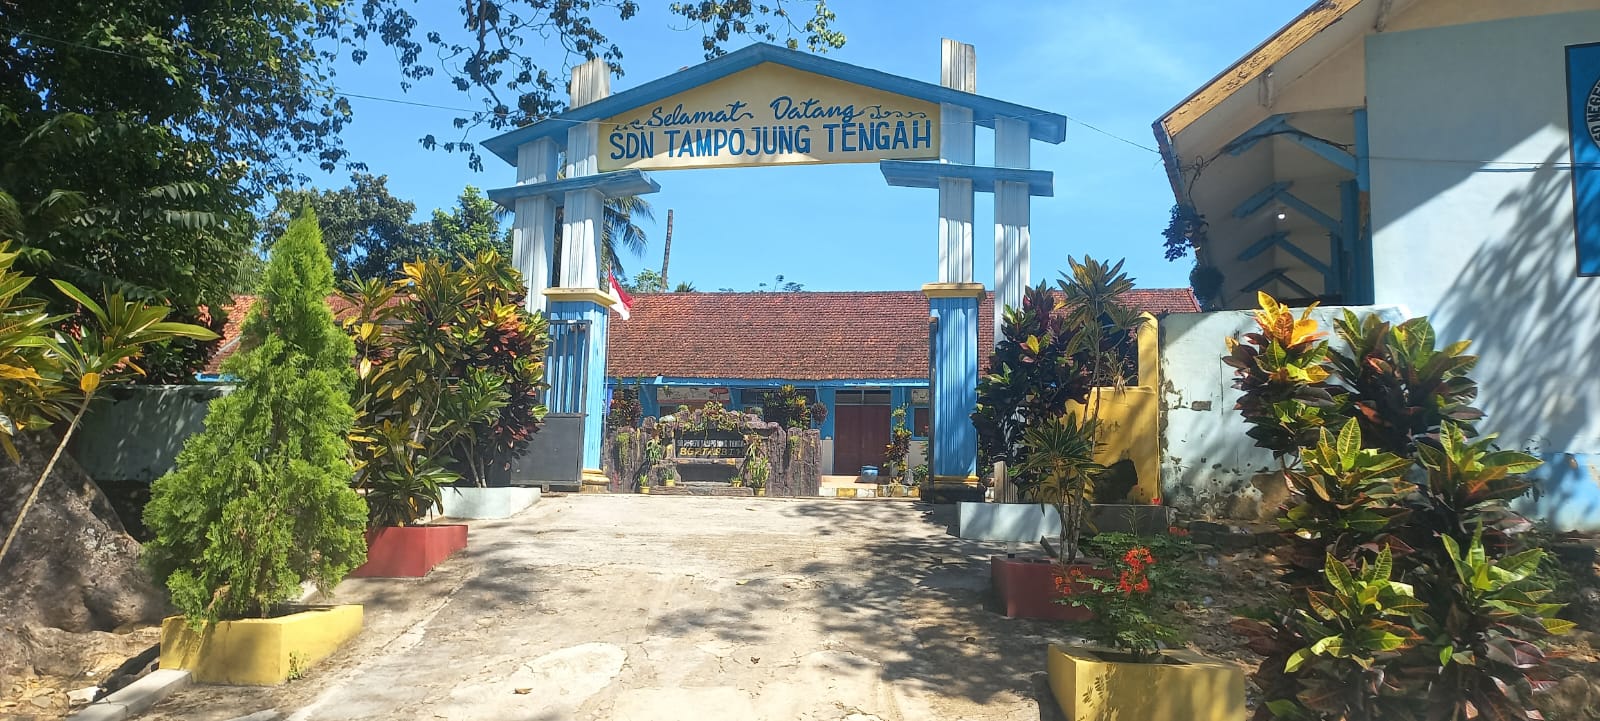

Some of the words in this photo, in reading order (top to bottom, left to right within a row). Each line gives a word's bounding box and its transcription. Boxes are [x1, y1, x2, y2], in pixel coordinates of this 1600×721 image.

[645, 101, 754, 127] Selamat
[770, 96, 862, 121] Datang
[609, 130, 654, 160] SDN
[664, 125, 811, 159] TAMPOJUNG
[823, 119, 931, 153] TENGAH
